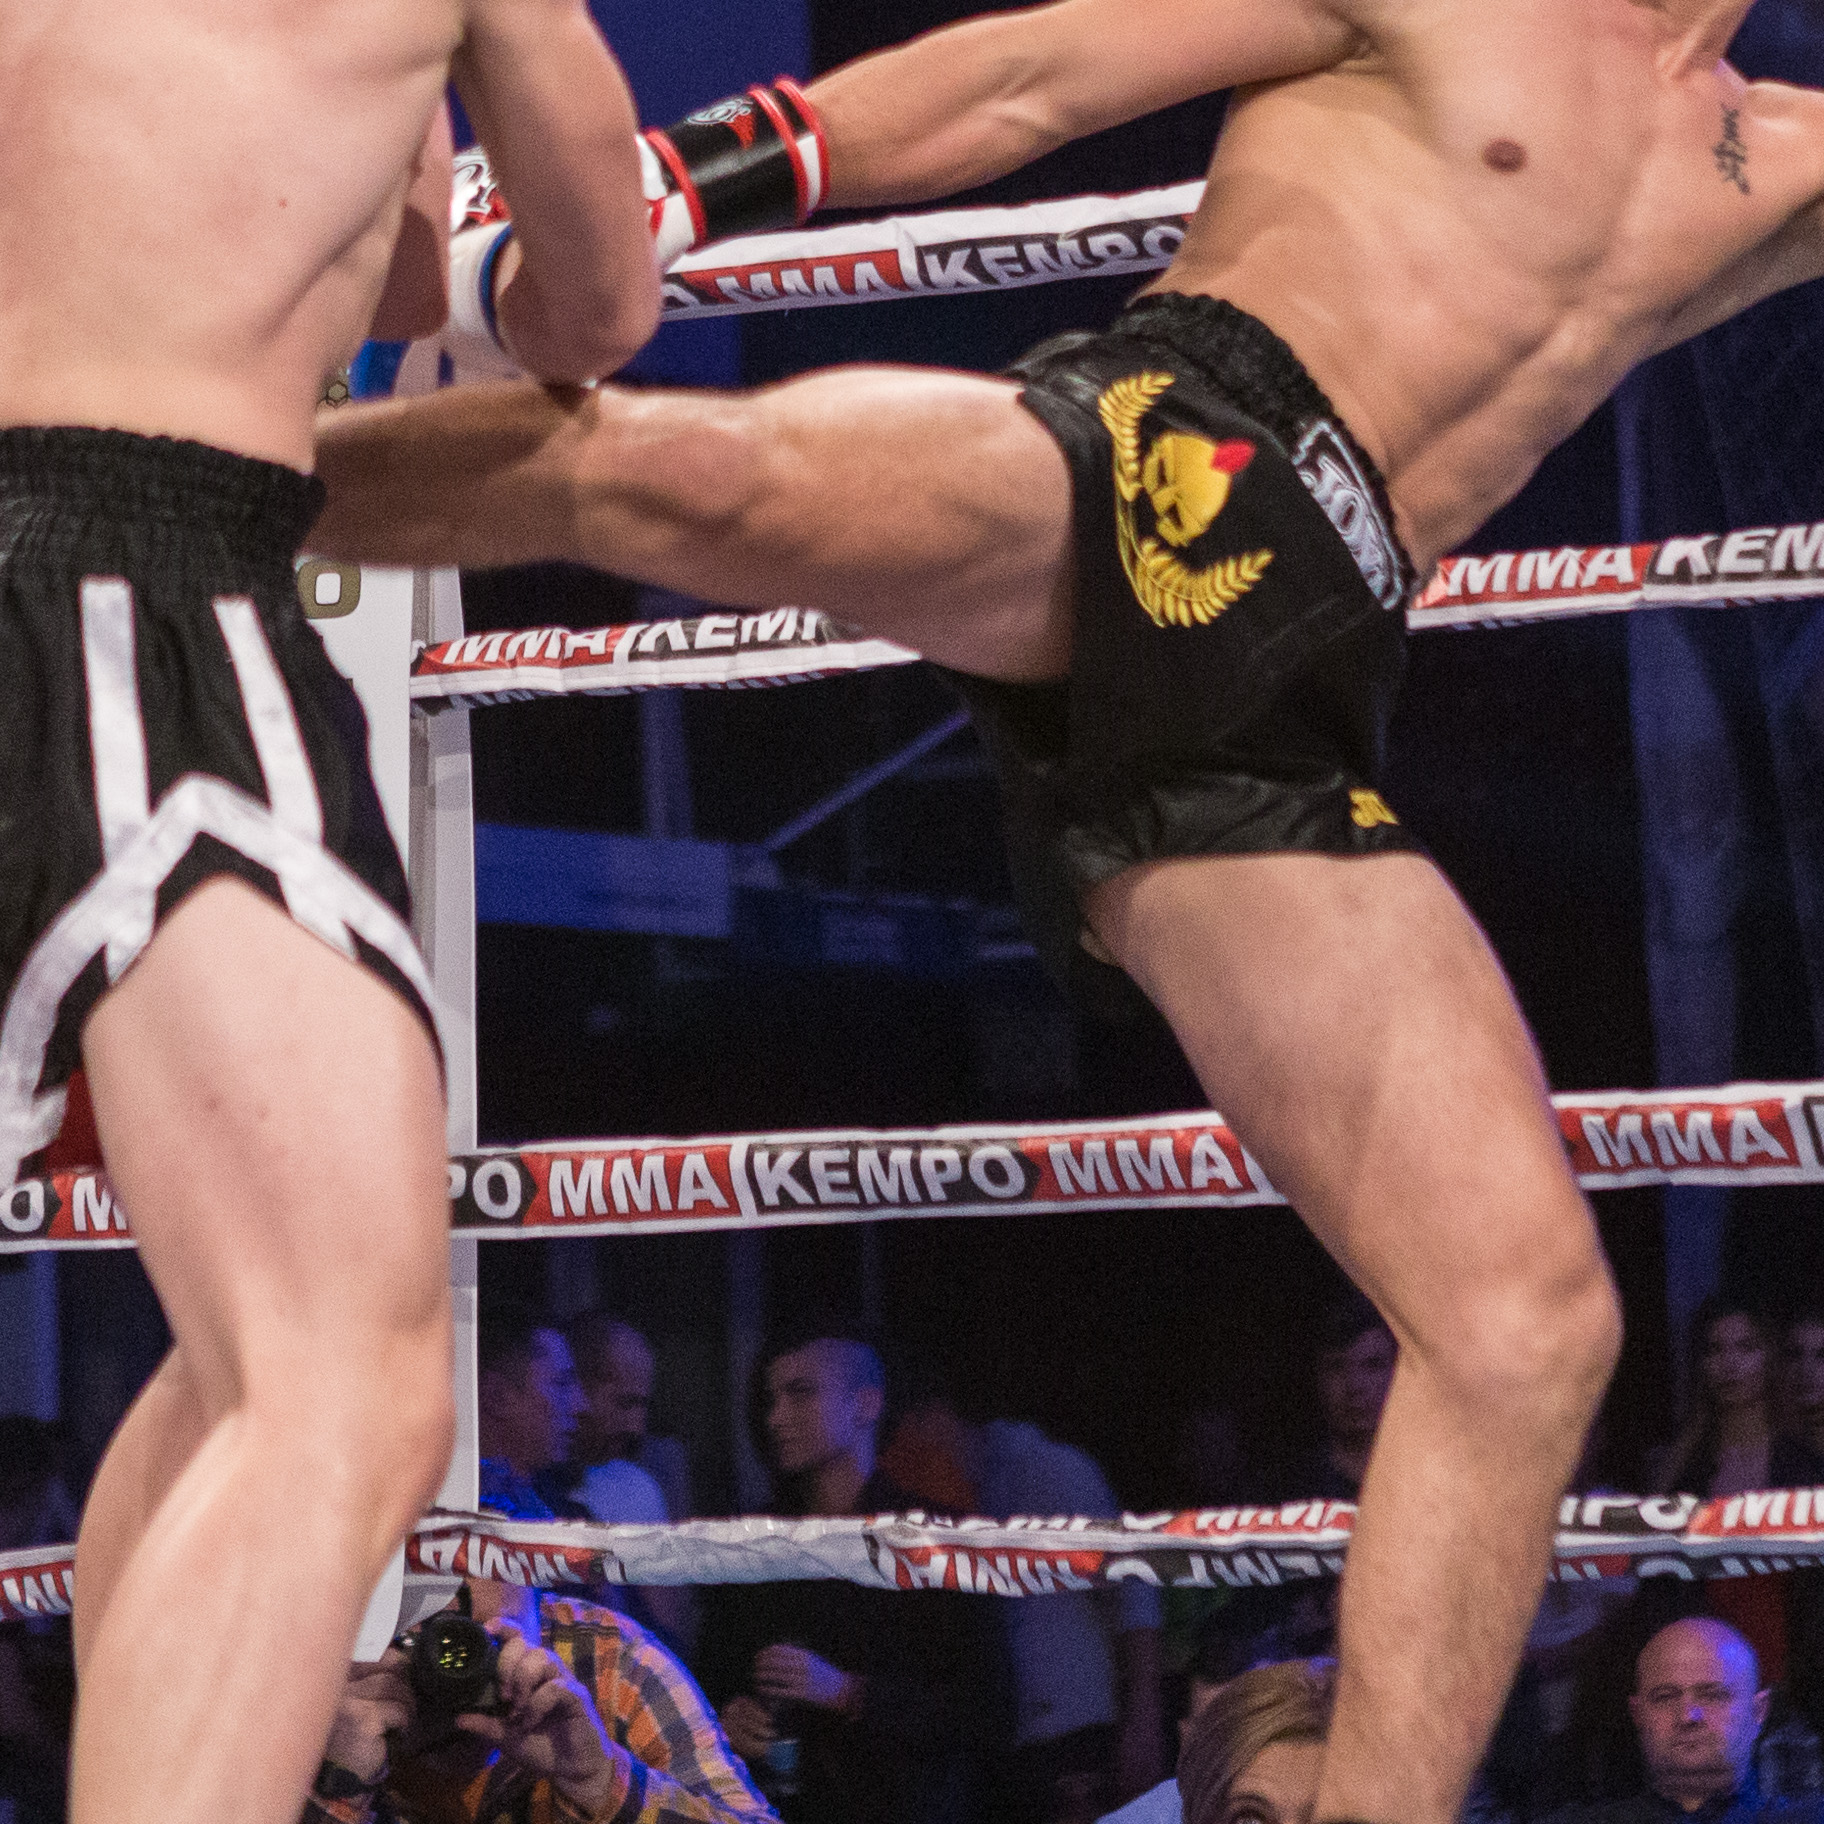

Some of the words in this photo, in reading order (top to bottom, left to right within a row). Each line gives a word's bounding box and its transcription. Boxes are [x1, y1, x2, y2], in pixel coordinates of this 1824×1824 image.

[1445, 545, 1636, 596] MMA
[443, 626, 612, 665] MMA
[1580, 1107, 1788, 1169] MMA
[549, 1148, 730, 1218] MMA
[753, 1146, 1027, 1206] KEMPO
[1052, 1133, 1241, 1195] MMA
